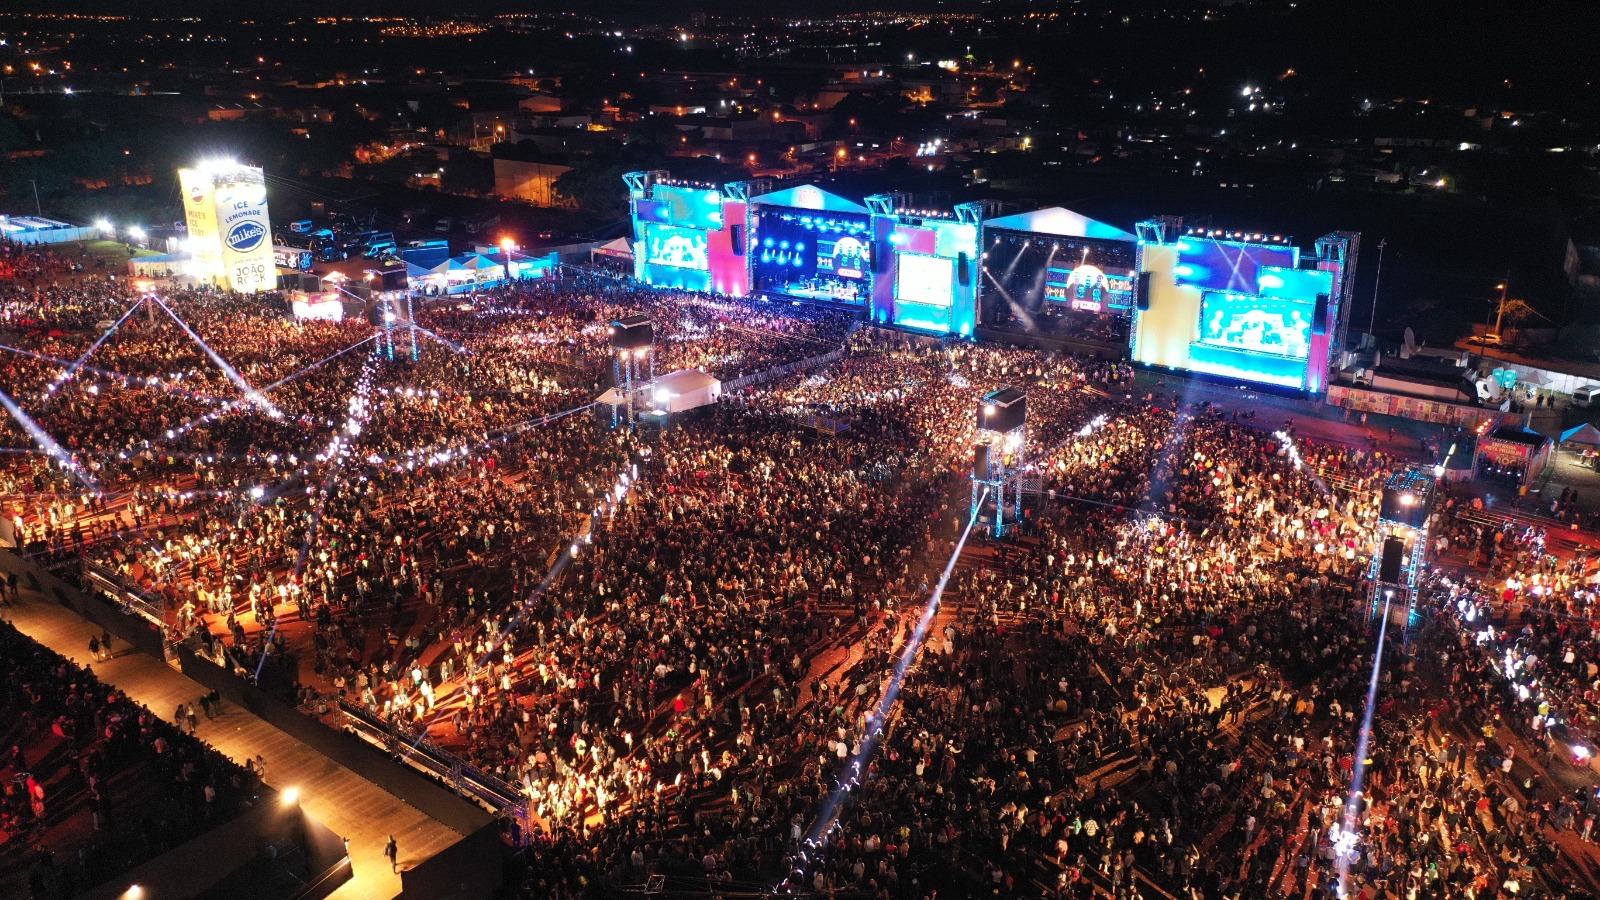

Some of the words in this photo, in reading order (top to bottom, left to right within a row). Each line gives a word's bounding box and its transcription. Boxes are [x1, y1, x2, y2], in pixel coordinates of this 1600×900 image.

[233, 201, 249, 210] ICE
[188, 210, 206, 220] MIKE'S
[225, 209, 261, 223] LEMONADE
[189, 219, 198, 227] ICE
[230, 227, 262, 245] mike's
[236, 263, 265, 277] JOÃO
[237, 273, 266, 286] ROCK
[1492, 442, 1516, 451] ENTRADA
[1499, 447, 1522, 456] PREMIUM
